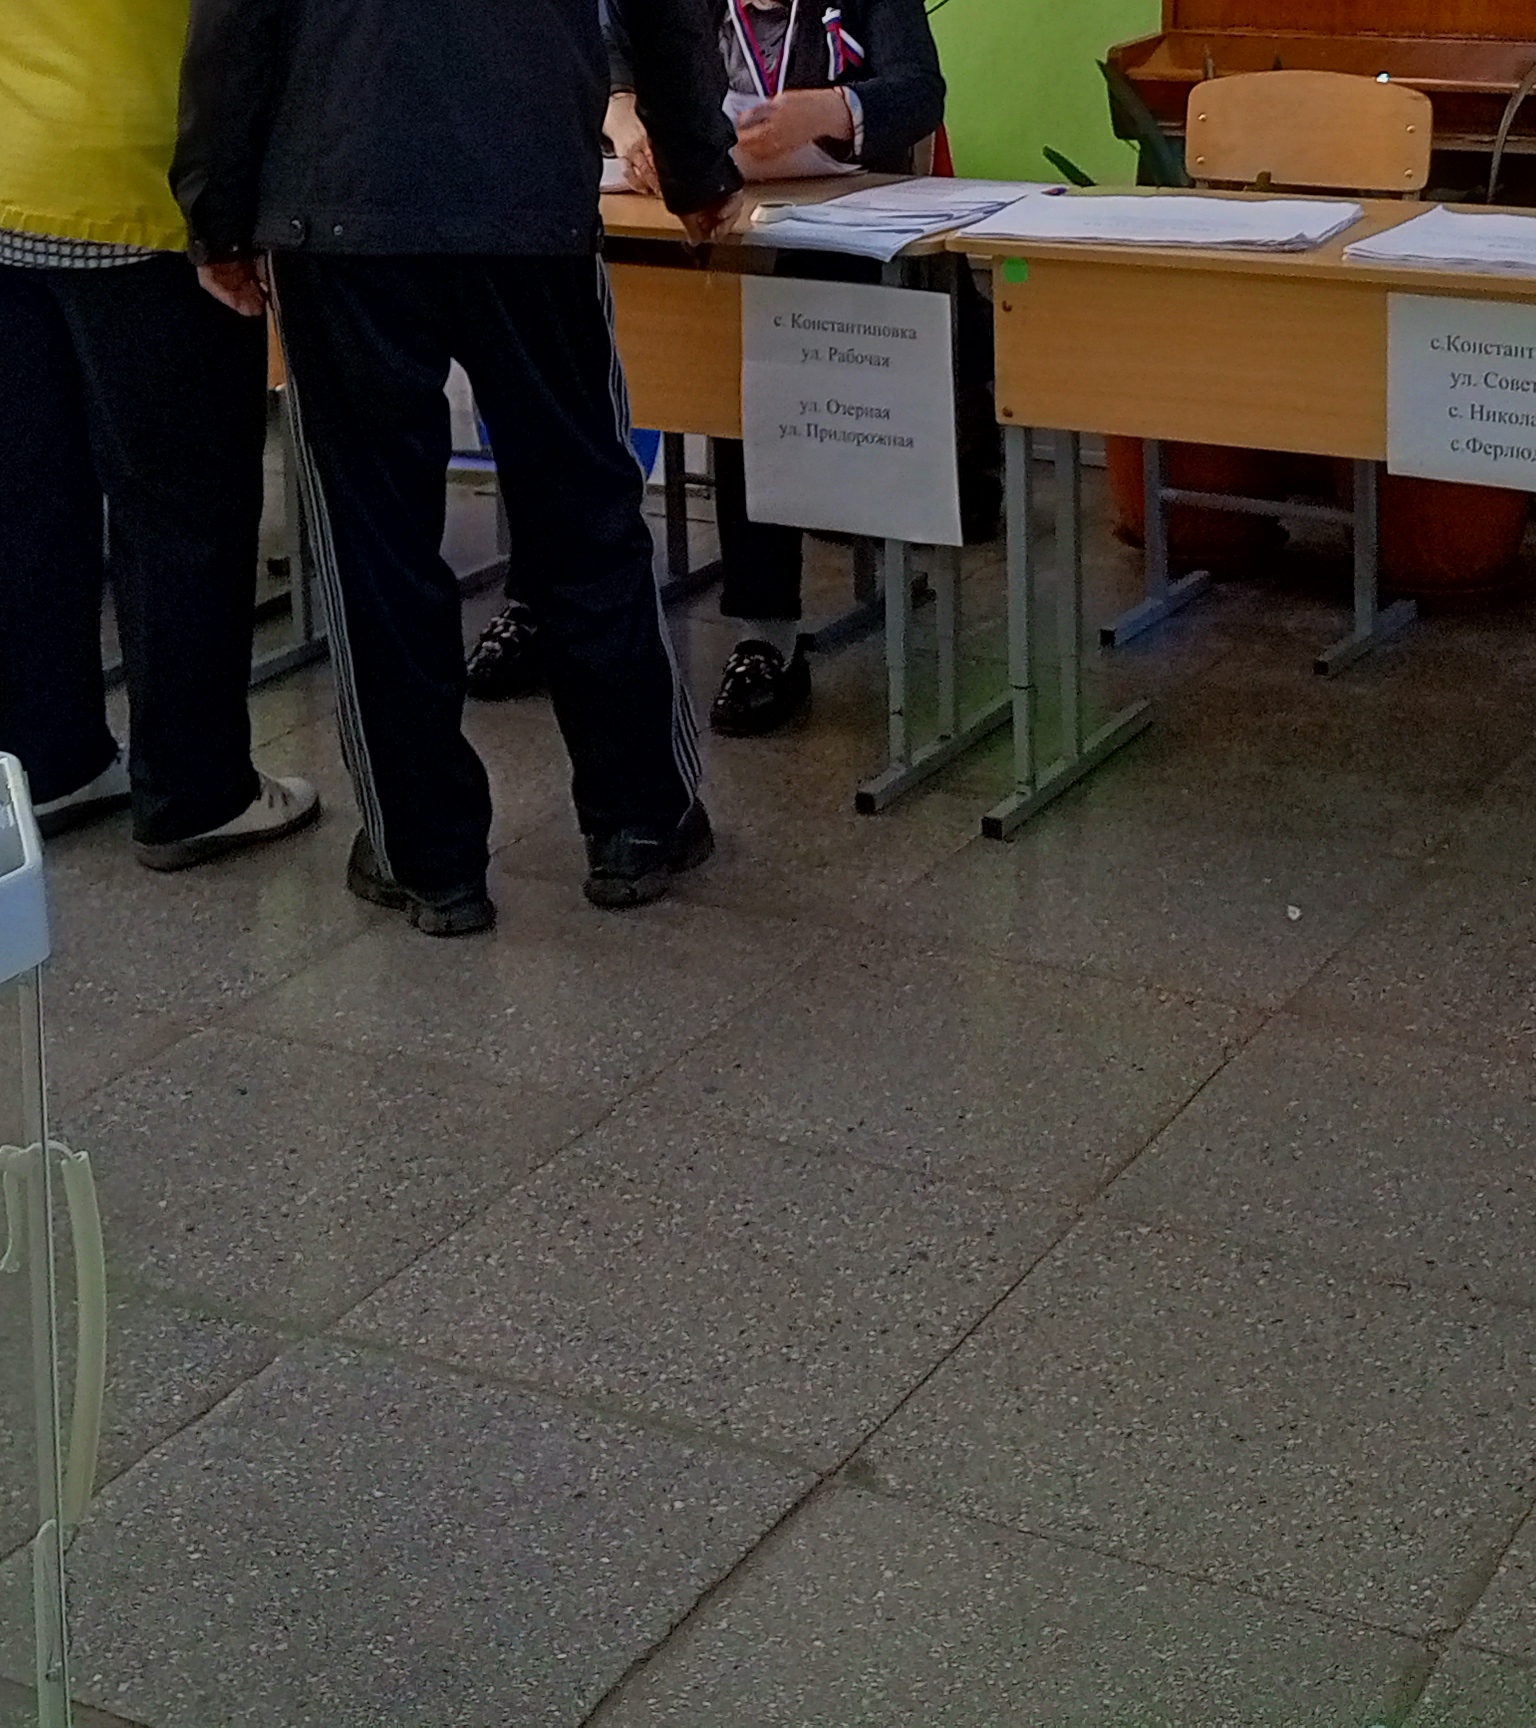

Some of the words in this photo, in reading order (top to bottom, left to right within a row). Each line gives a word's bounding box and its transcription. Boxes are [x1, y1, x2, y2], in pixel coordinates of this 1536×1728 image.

[790, 313, 918, 340] Константиновка
[801, 347, 821, 363] ул.
[828, 346, 891, 368] Рабочая
[1449, 372, 1477, 390] ул.
[799, 400, 820, 415] ул.
[826, 399, 891, 421] Озерная
[1448, 405, 1462, 419] с.
[779, 423, 801, 439] ул.
[806, 422, 915, 449] Придорожная
